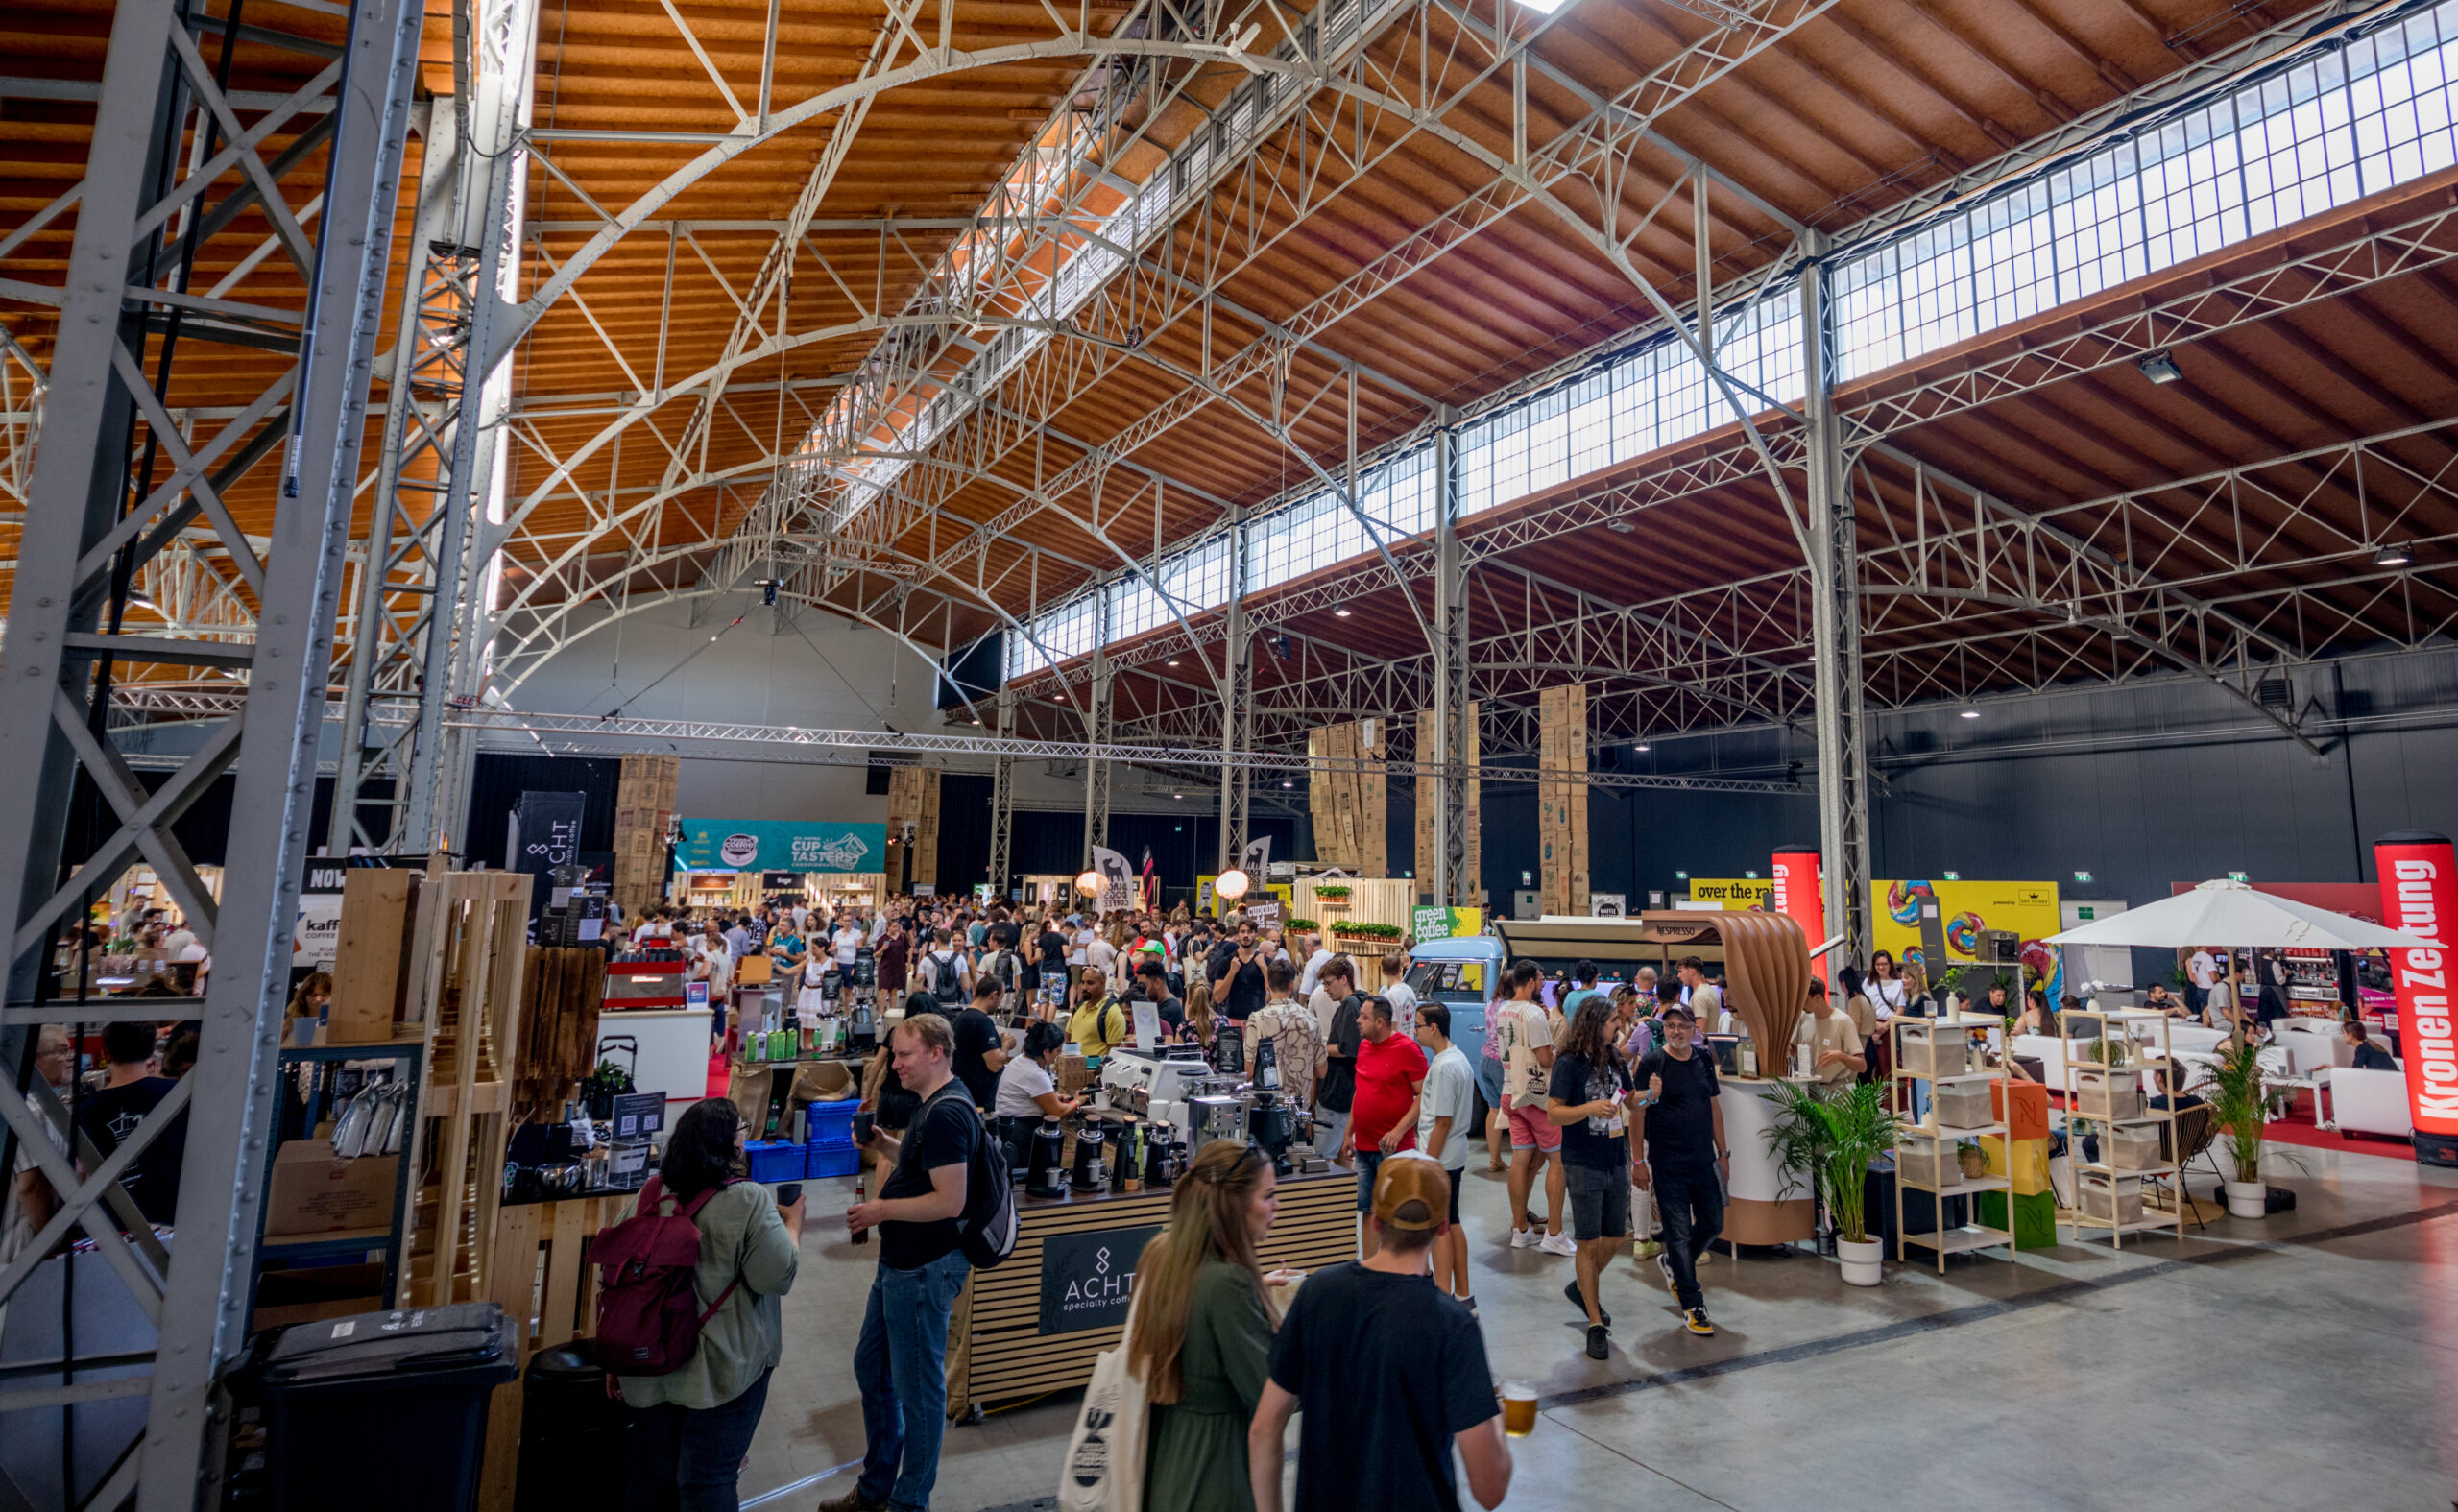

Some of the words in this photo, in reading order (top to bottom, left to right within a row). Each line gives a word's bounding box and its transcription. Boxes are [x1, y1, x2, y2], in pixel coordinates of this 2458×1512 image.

[791, 841, 821, 852] CUP
[791, 852, 853, 862] TASTERS
[1699, 886, 1728, 899] over
[1731, 882, 1752, 899] the
[1247, 900, 1280, 918] cupping
[1415, 907, 1447, 926] green
[306, 919, 340, 931] kaff
[1416, 920, 1449, 938] coffee
[1656, 924, 1696, 937] NESPRESSO
[2395, 859, 2446, 990] Zetung
[2413, 995, 2458, 1119] Kronen
[1065, 1272, 1137, 1302] ACHT
[1063, 1298, 1108, 1312] specialty
